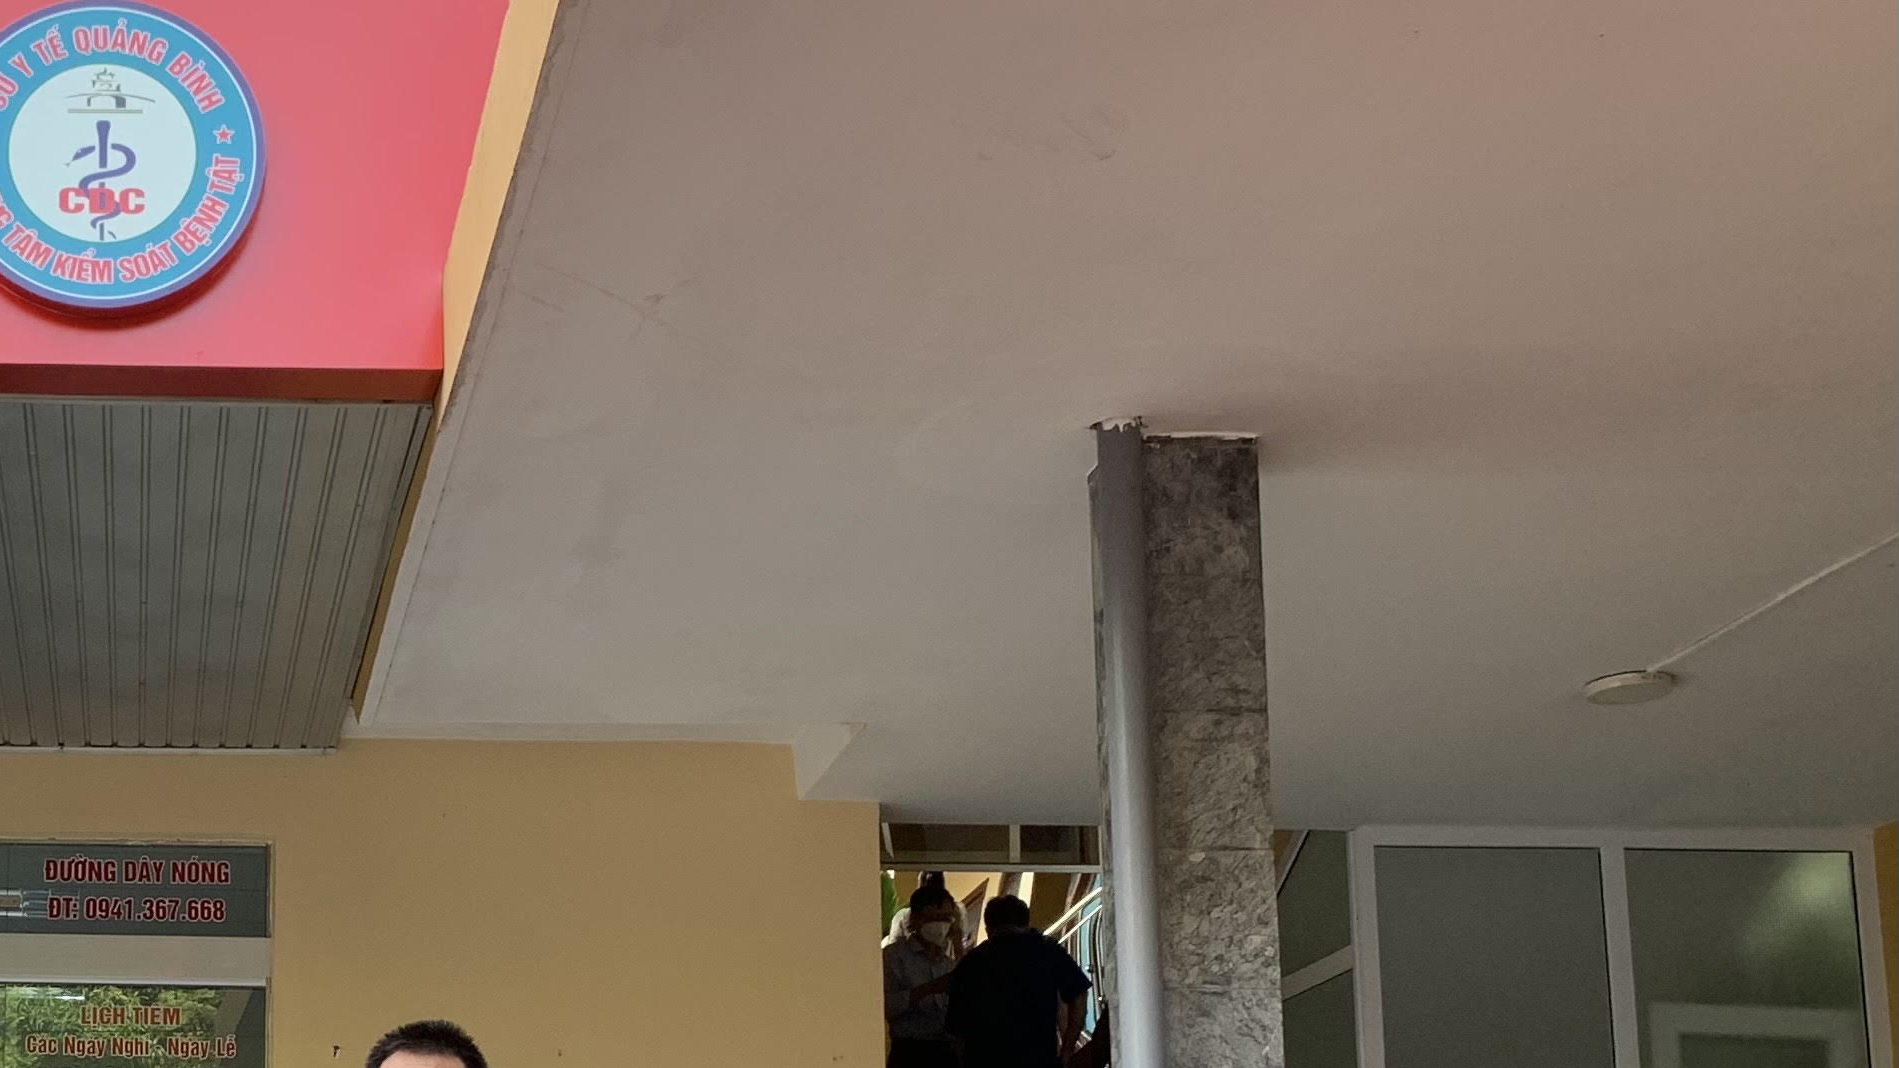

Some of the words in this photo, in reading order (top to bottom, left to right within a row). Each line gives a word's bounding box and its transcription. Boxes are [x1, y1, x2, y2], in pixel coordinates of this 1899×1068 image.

[9, 53, 34, 77] Y
[31, 24, 67, 66] TẾ
[72, 18, 169, 64] QUẢNG
[166, 52, 224, 113] BÌNH
[58, 187, 145, 215] CDC
[2, 220, 54, 269] TÂM
[52, 248, 114, 284] KIỂM
[119, 239, 178, 283] SOÁT
[171, 199, 228, 255] BỆNH
[206, 155, 245, 195] TẬT
[44, 854, 117, 885] ĐƯỜNG
[123, 854, 166, 885] DÂY
[170, 855, 231, 885] NÓNG
[83, 896, 226, 922] 0941.367.668
[80, 1005, 126, 1029] LỊCH
[132, 1003, 182, 1026] TIÊM
[25, 1034, 58, 1056] Các
[63, 1034, 106, 1058] Ngày
[166, 1035, 211, 1059] Ngày
[215, 1033, 237, 1059] Lễ
